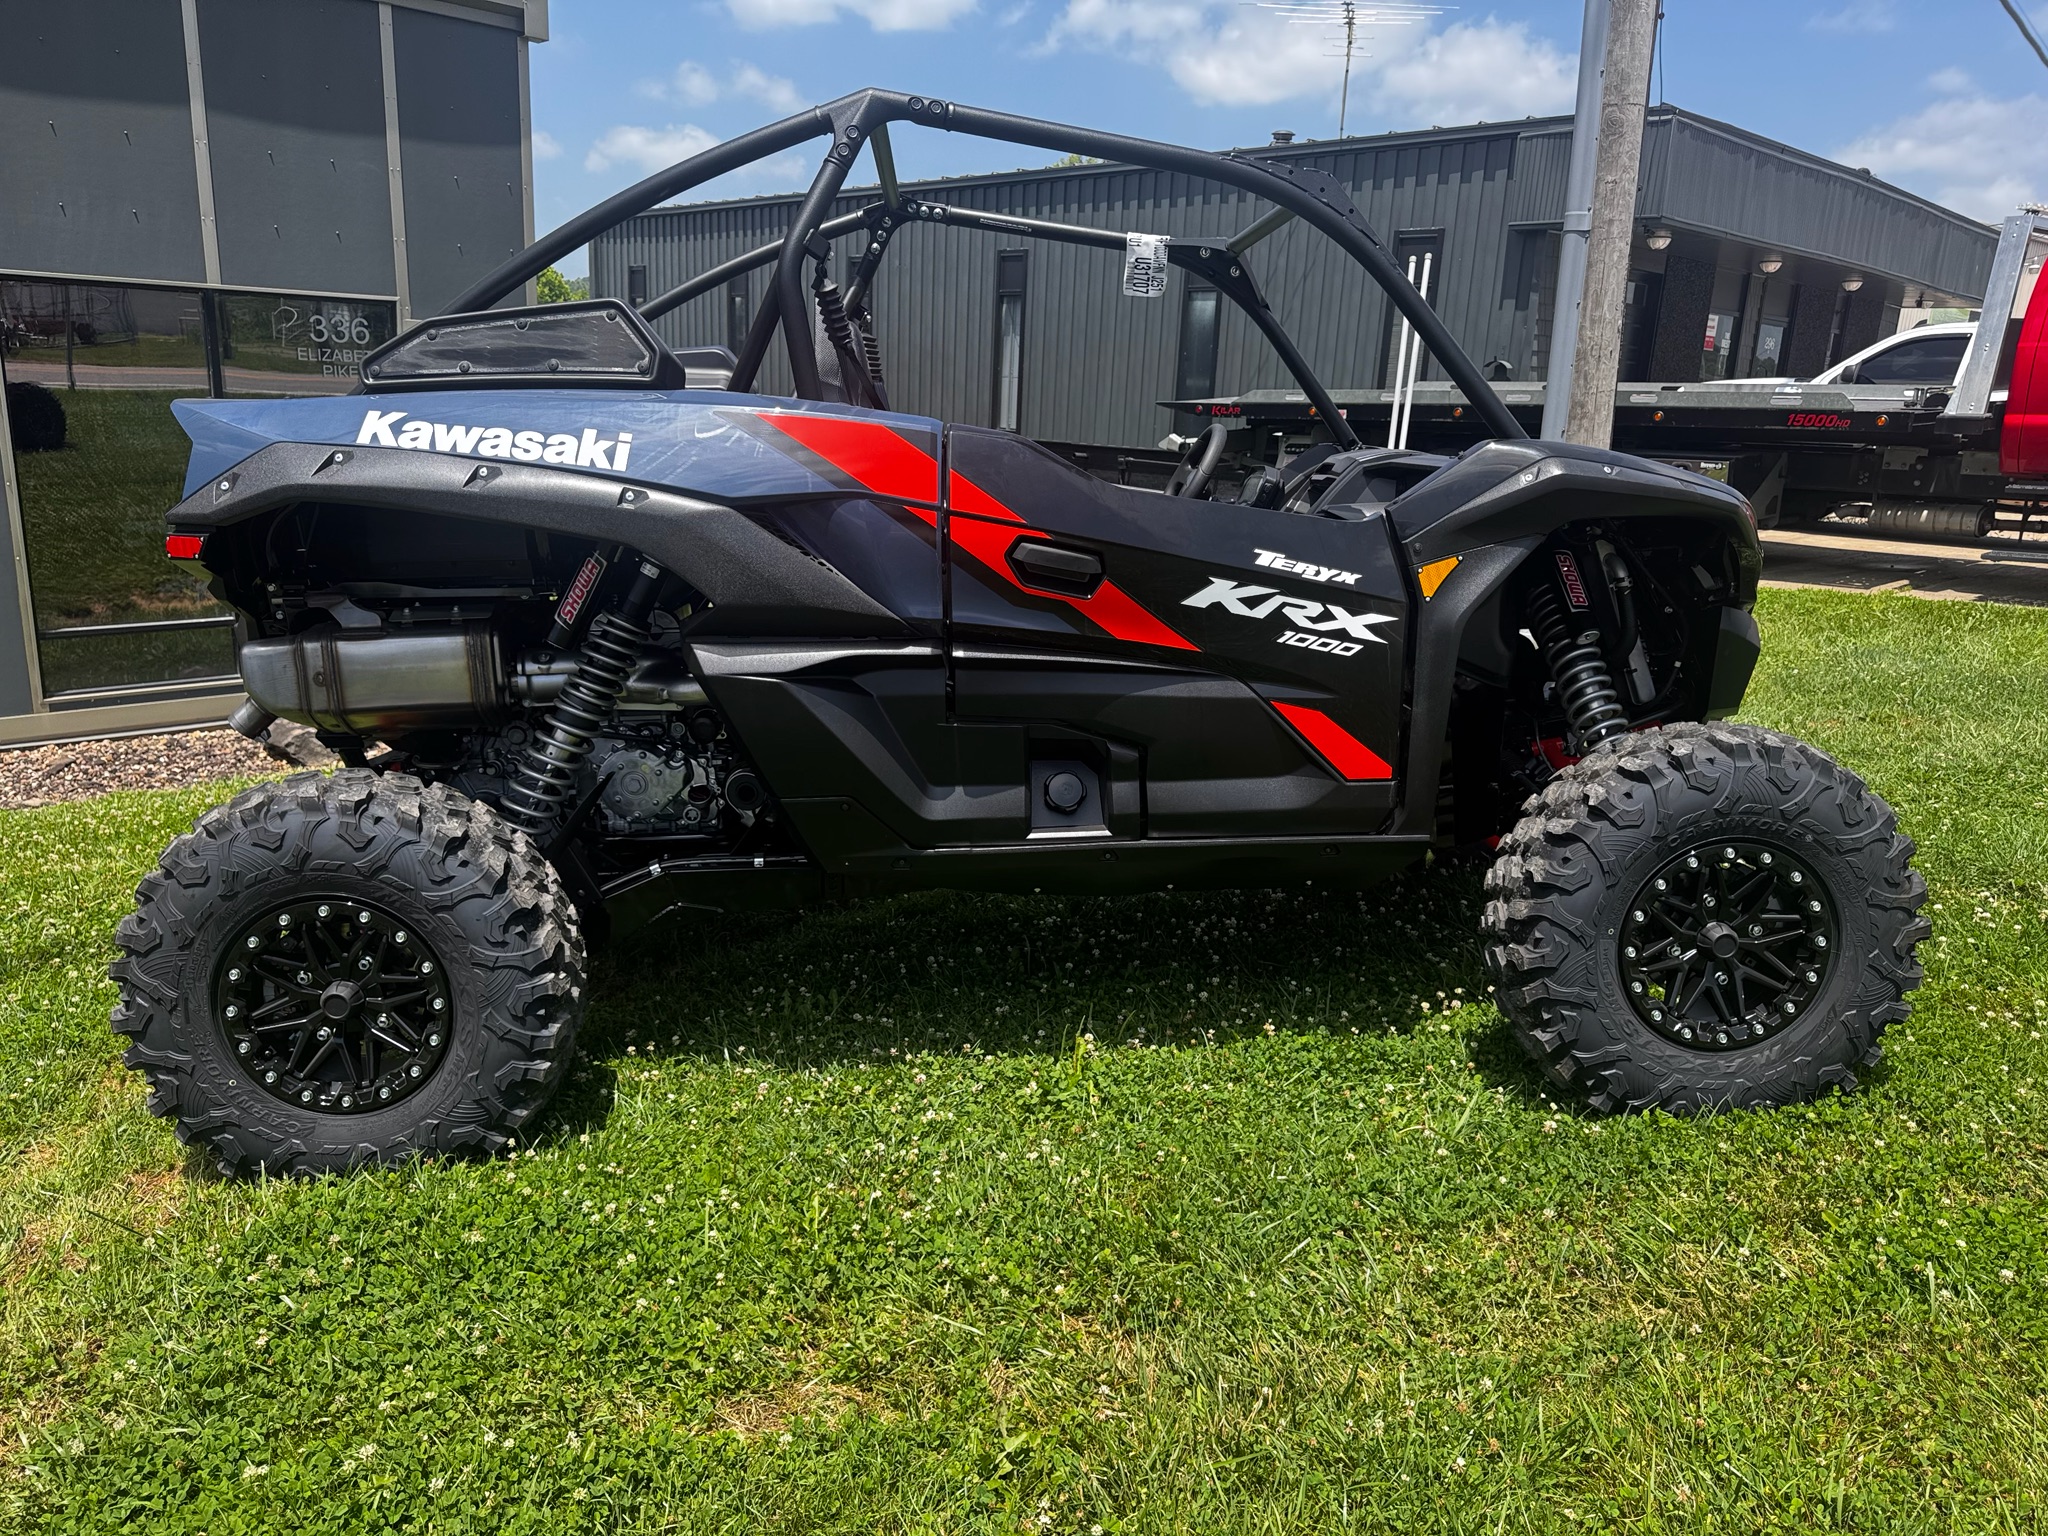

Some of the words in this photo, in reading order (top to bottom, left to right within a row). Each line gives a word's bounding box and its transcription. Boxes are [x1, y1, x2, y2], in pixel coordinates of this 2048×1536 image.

[1132, 257, 1152, 294] U31707
[1151, 275, 1165, 291] J251
[309, 315, 370, 344] 336
[323, 364, 359, 378] PIKE
[1211, 405, 1241, 415] KILAR
[355, 410, 633, 471] Kawasaki
[560, 557, 600, 625] SHOWA
[1555, 554, 1589, 606] SHOWA
[1179, 576, 1400, 645] KRX
[1276, 630, 1364, 657] 1000
